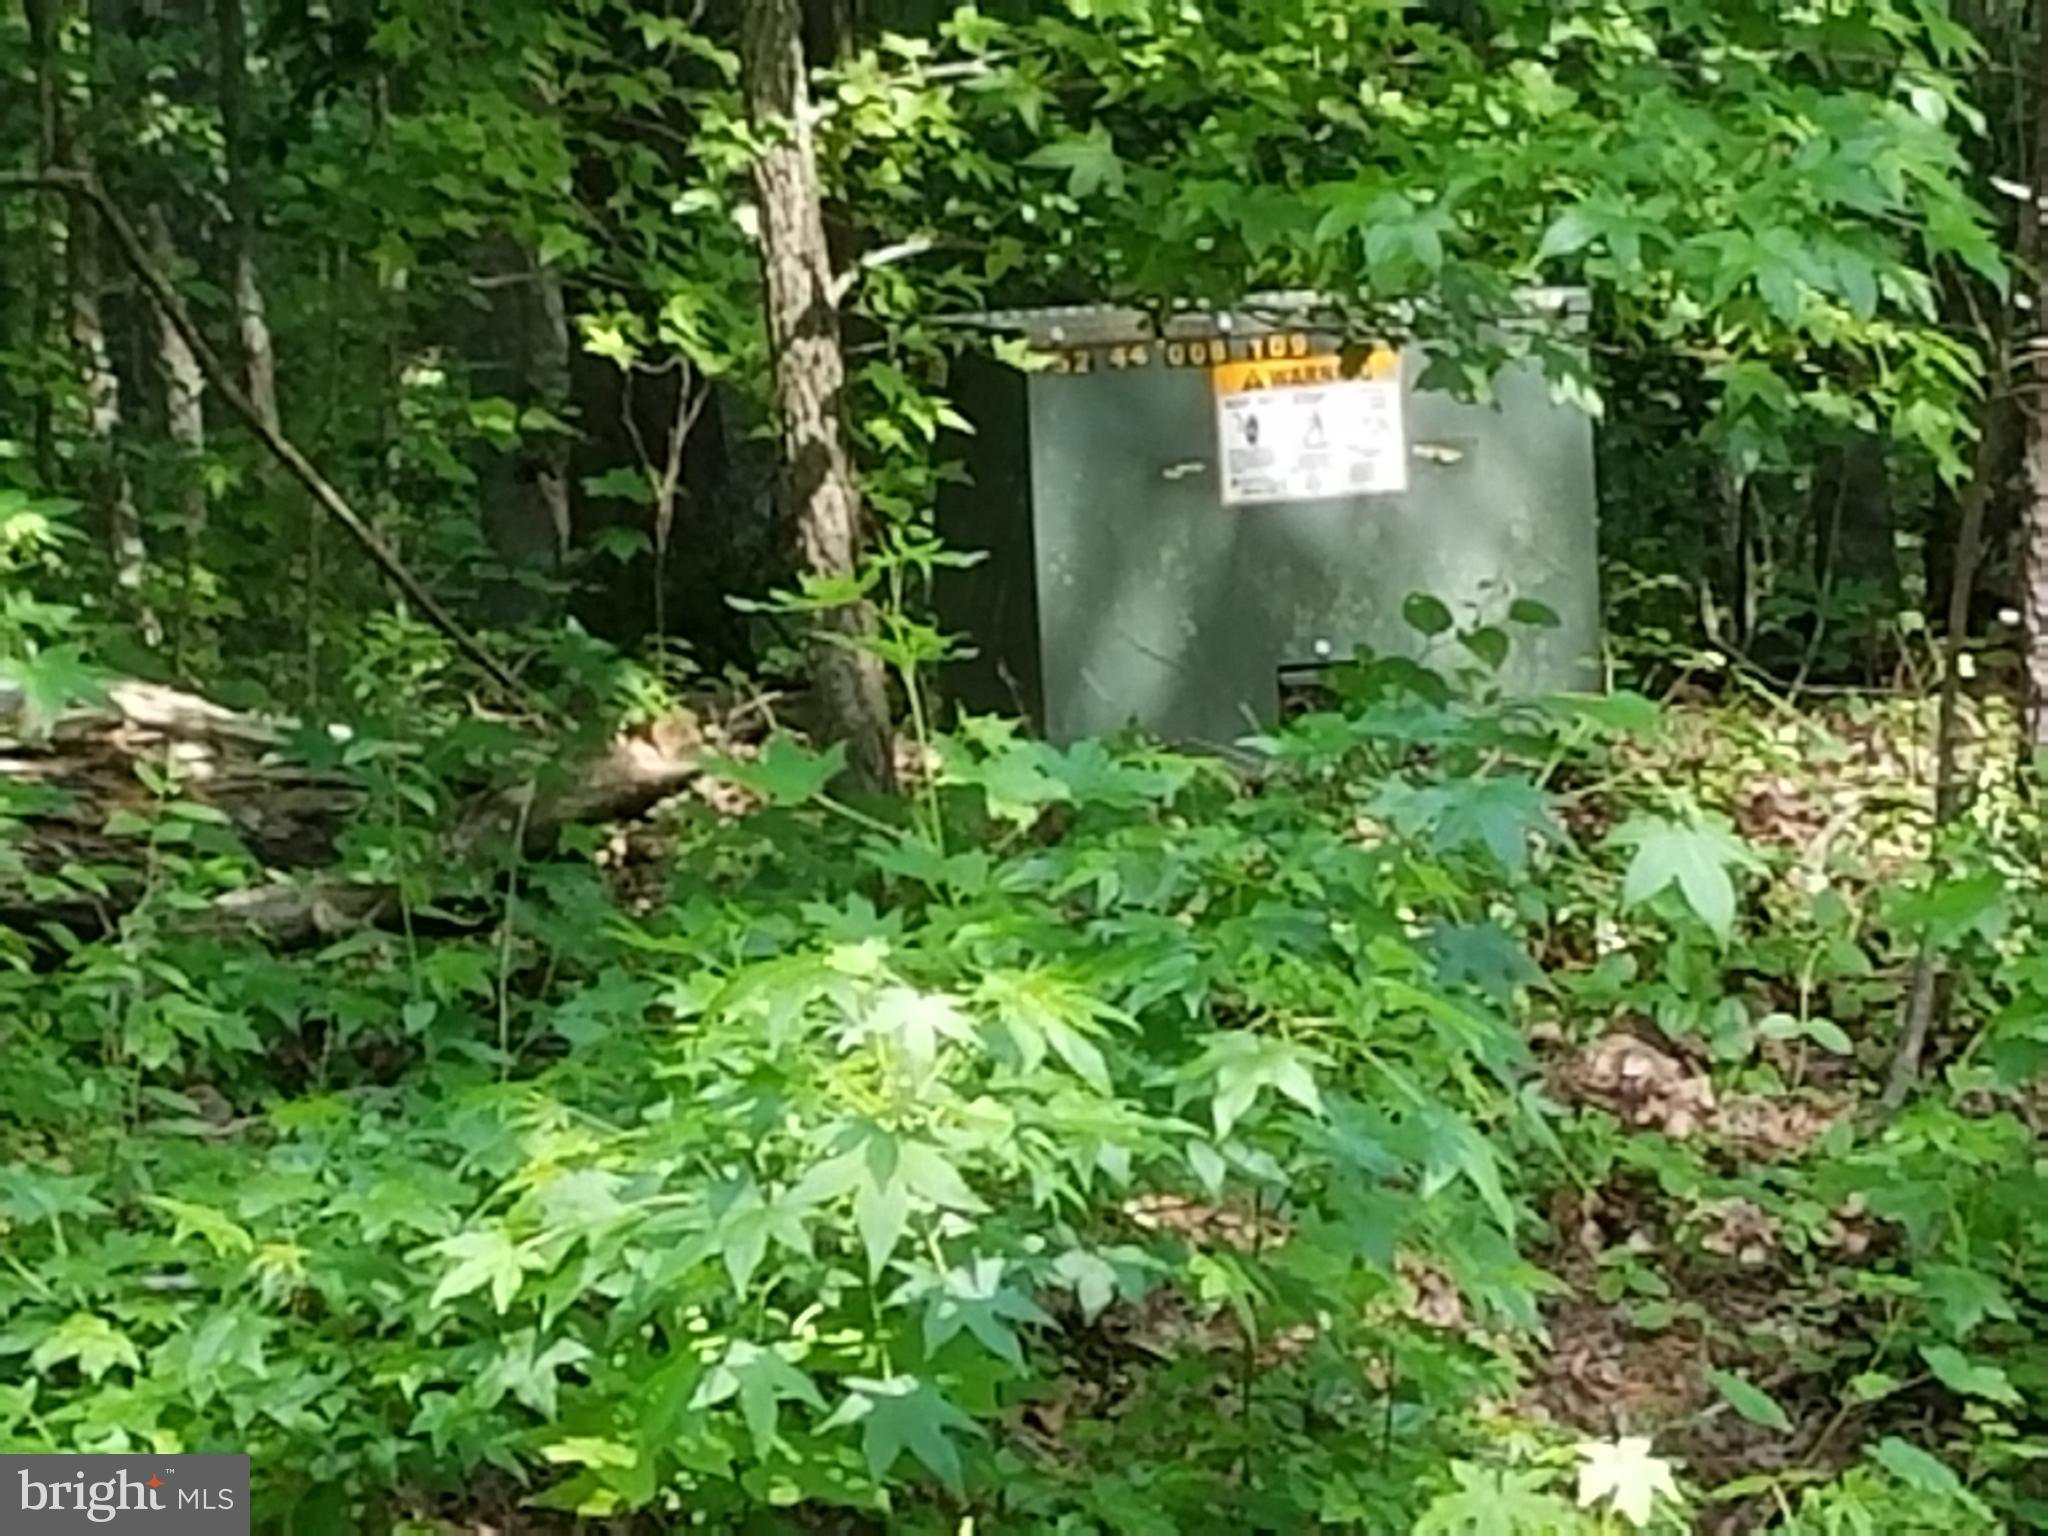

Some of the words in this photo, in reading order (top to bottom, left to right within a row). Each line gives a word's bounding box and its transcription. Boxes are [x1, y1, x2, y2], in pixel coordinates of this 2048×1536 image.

[1109, 344, 1148, 368] 44
[1249, 333, 1307, 360] 109
[1270, 360, 1373, 388] WARN
